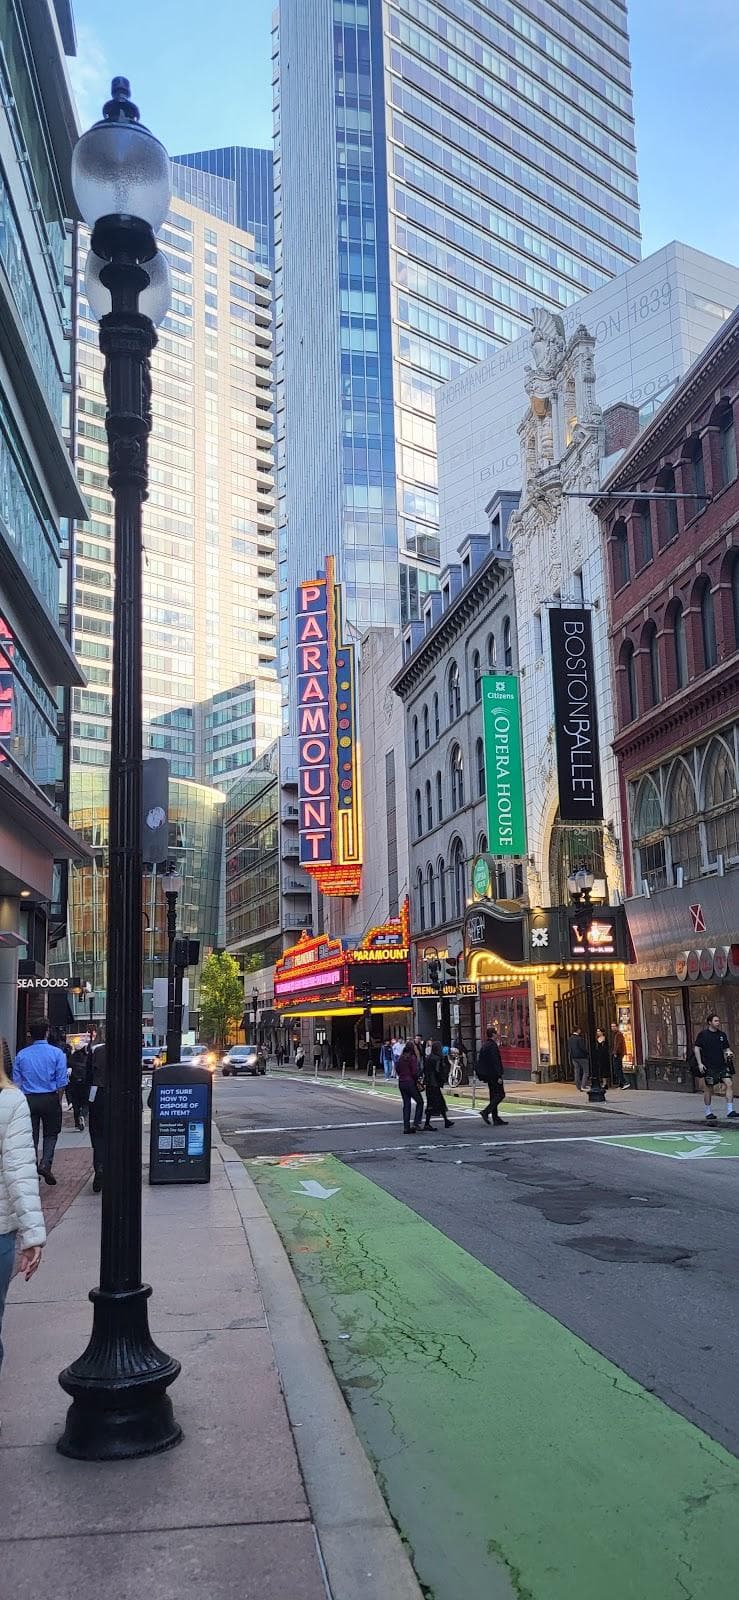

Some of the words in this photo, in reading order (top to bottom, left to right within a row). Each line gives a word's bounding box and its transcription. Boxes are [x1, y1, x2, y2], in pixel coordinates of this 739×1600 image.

[630, 281, 673, 323] 1839
[480, 453, 520, 481] BIJO
[487, 691, 515, 701] Citizens
[300, 587, 327, 860] PARAMOUNT
[493, 716, 511, 783] OPERA
[496, 784, 514, 847] HOUSE
[353, 948, 409, 961] PARAMOUNT
[17, 978, 34, 988] SEA
[35, 978, 69, 988] FOODS
